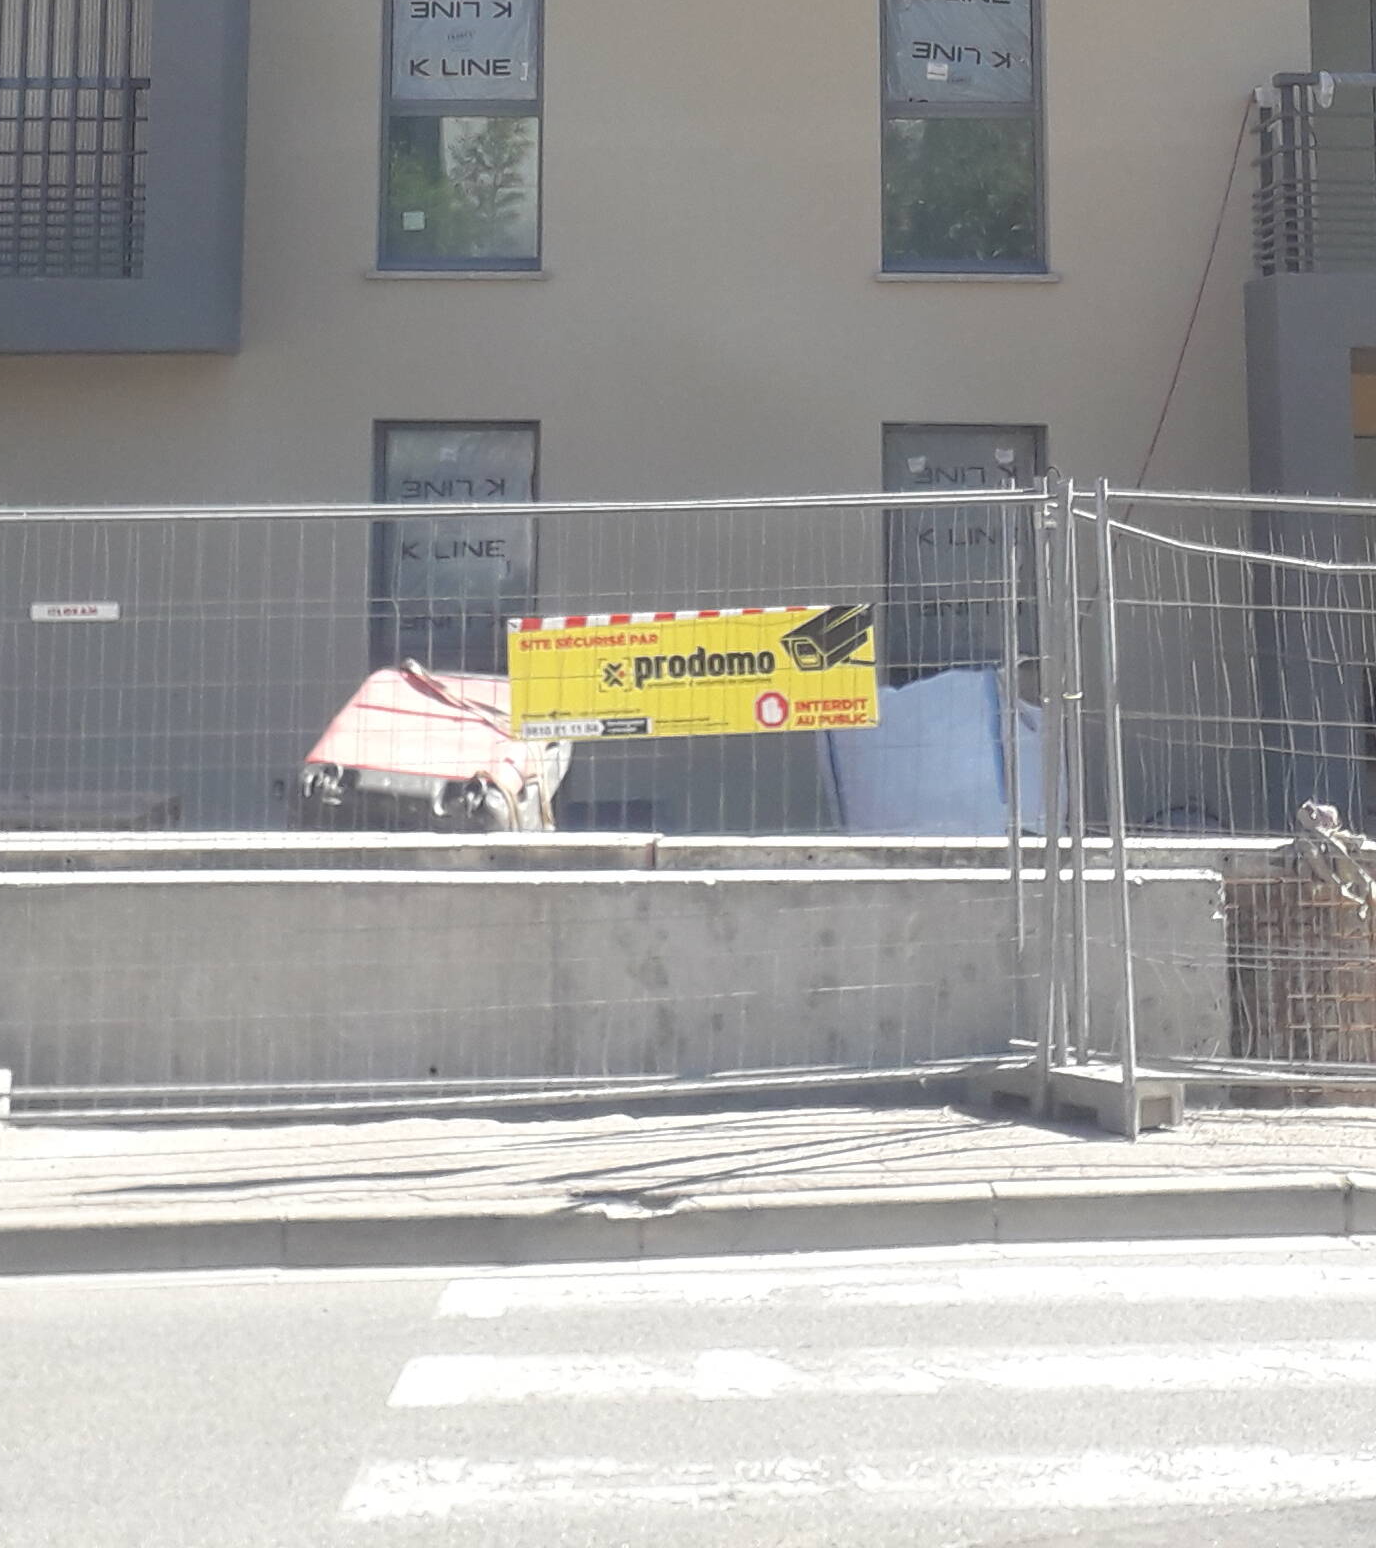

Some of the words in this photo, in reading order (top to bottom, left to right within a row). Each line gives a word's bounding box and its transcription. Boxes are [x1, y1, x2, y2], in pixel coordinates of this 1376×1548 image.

[410, 1, 481, 19] LINE
[492, 1, 512, 19] K
[912, 41, 981, 64] LINE
[991, 51, 1011, 69] K
[410, 59, 429, 77] K
[442, 59, 511, 77] LINE
[401, 479, 475, 498] LINE
[485, 478, 505, 496] K
[402, 541, 421, 559] K
[435, 540, 506, 559] LINE
[520, 638, 552, 651] SITE
[555, 634, 625, 650] SÉCURISÉ
[629, 633, 658, 646] PAR
[634, 646, 776, 689] prodomo
[795, 698, 868, 712] INTERDIT
[796, 714, 815, 726] AU
[819, 713, 867, 726] PUBLIC
